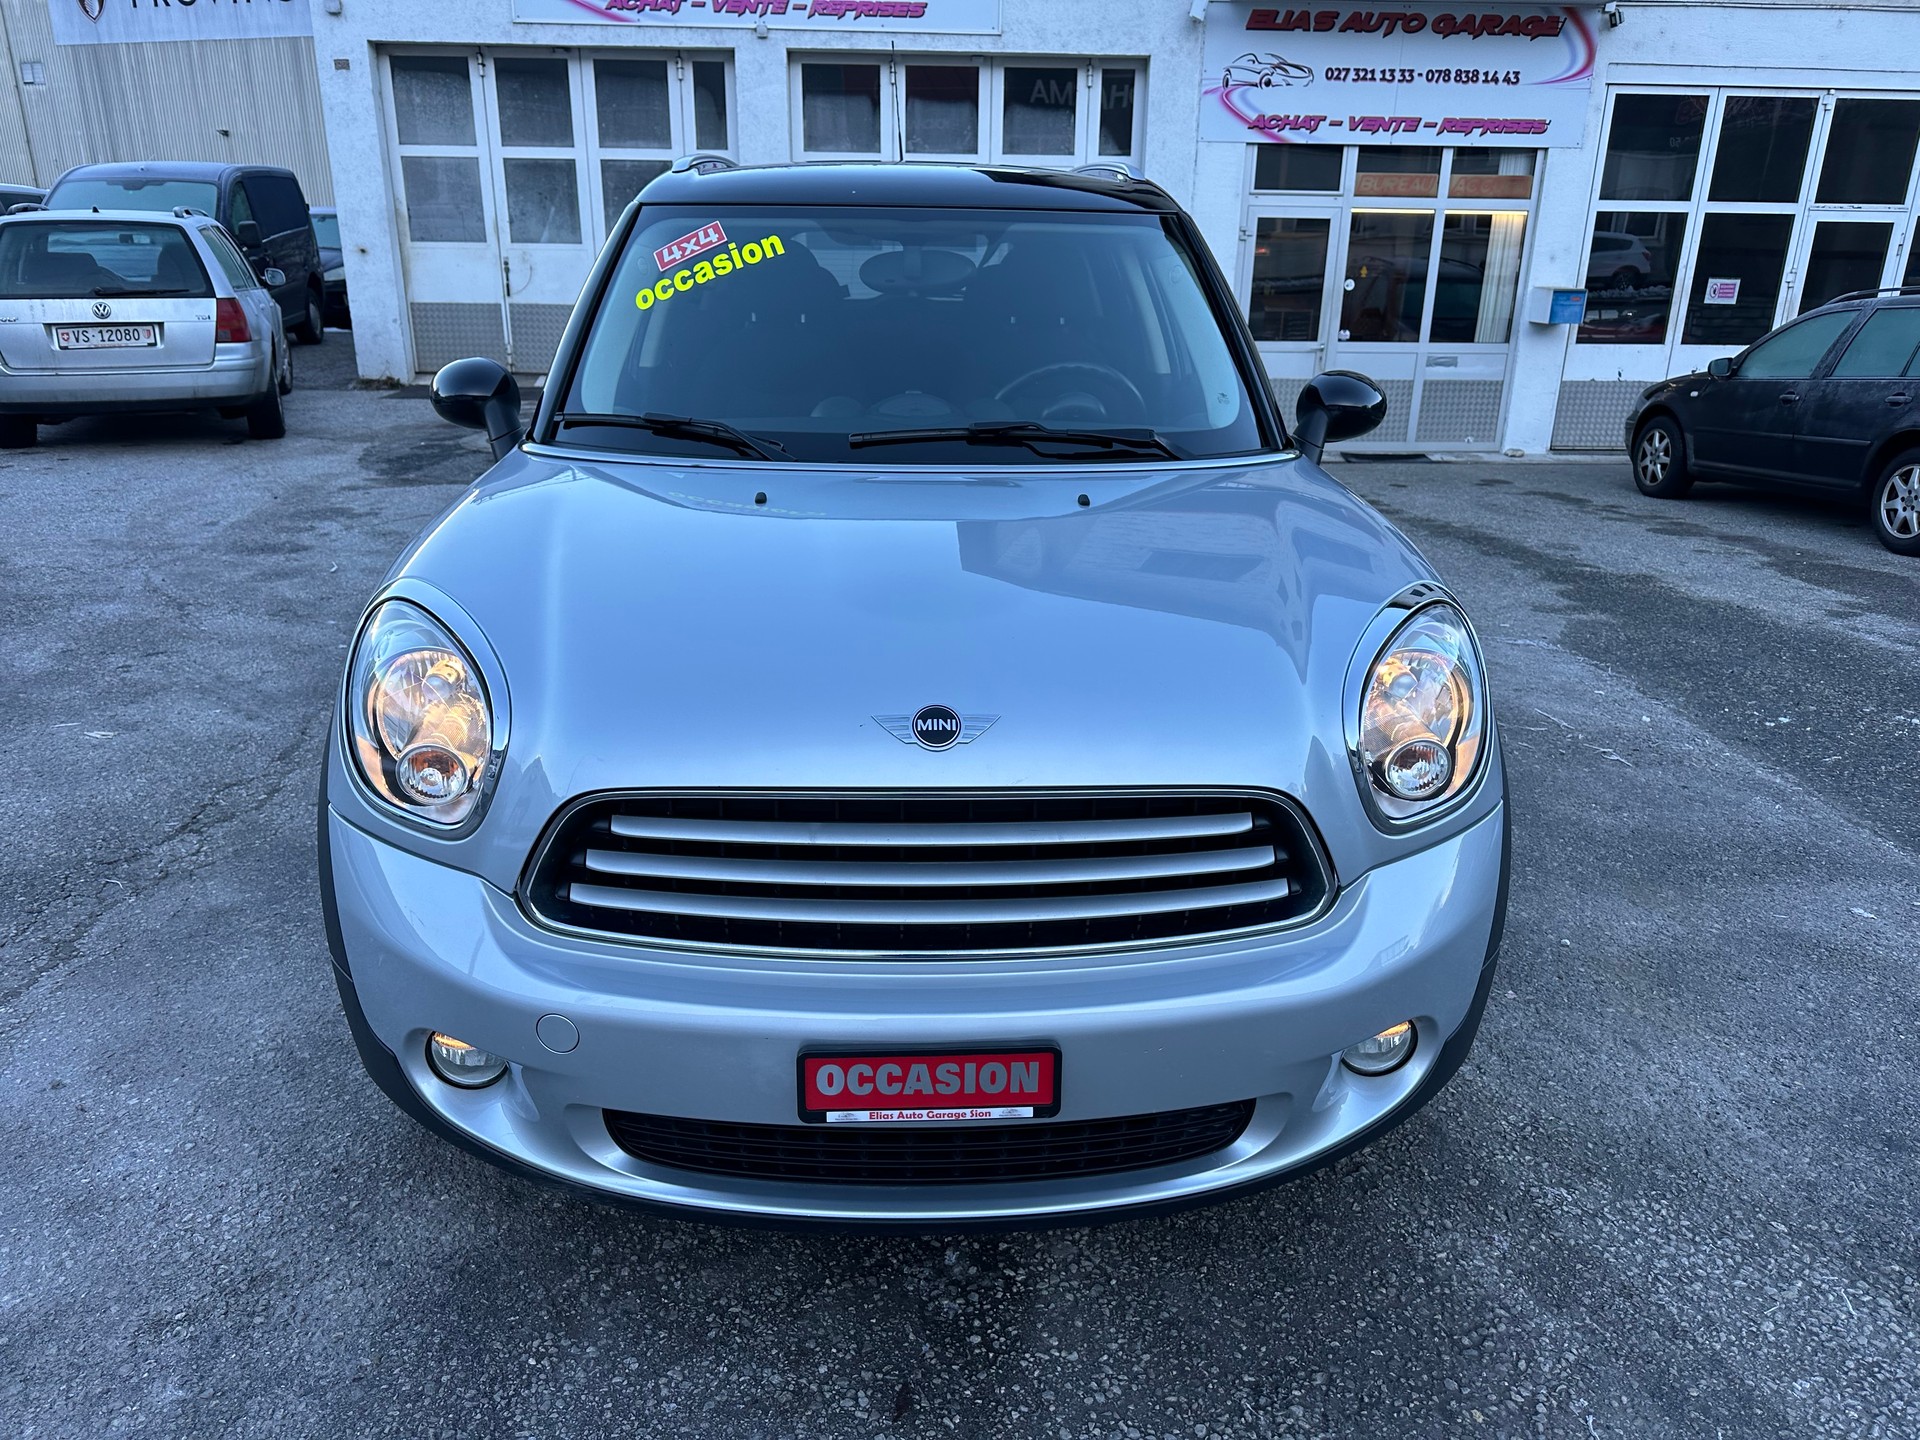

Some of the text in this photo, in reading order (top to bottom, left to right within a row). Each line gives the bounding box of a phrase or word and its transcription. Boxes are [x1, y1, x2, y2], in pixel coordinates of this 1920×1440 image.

[605, 0, 688, 15] ACHAT
[712, 0, 790, 18] VENTE
[807, 1, 928, 20] REPRISES
[1246, 9, 1567, 41] ELIAS AUTO GARAGE
[1325, 67, 1350, 82] 027
[1352, 68, 1376, 82] 321
[1425, 69, 1451, 84] 078
[1454, 69, 1479, 84] 838
[1248, 114, 1327, 134] ACHAT
[1348, 116, 1422, 136] VENTE
[1436, 117, 1551, 137] REPRISES
[1361, 176, 1435, 193] BUREAU
[662, 227, 719, 263] 4x4
[635, 234, 785, 310] occasion
[917, 719, 956, 731] MINI
[816, 1061, 1039, 1096] OCCASION
[869, 1109, 991, 1120] Elias Auto Garage Sion
